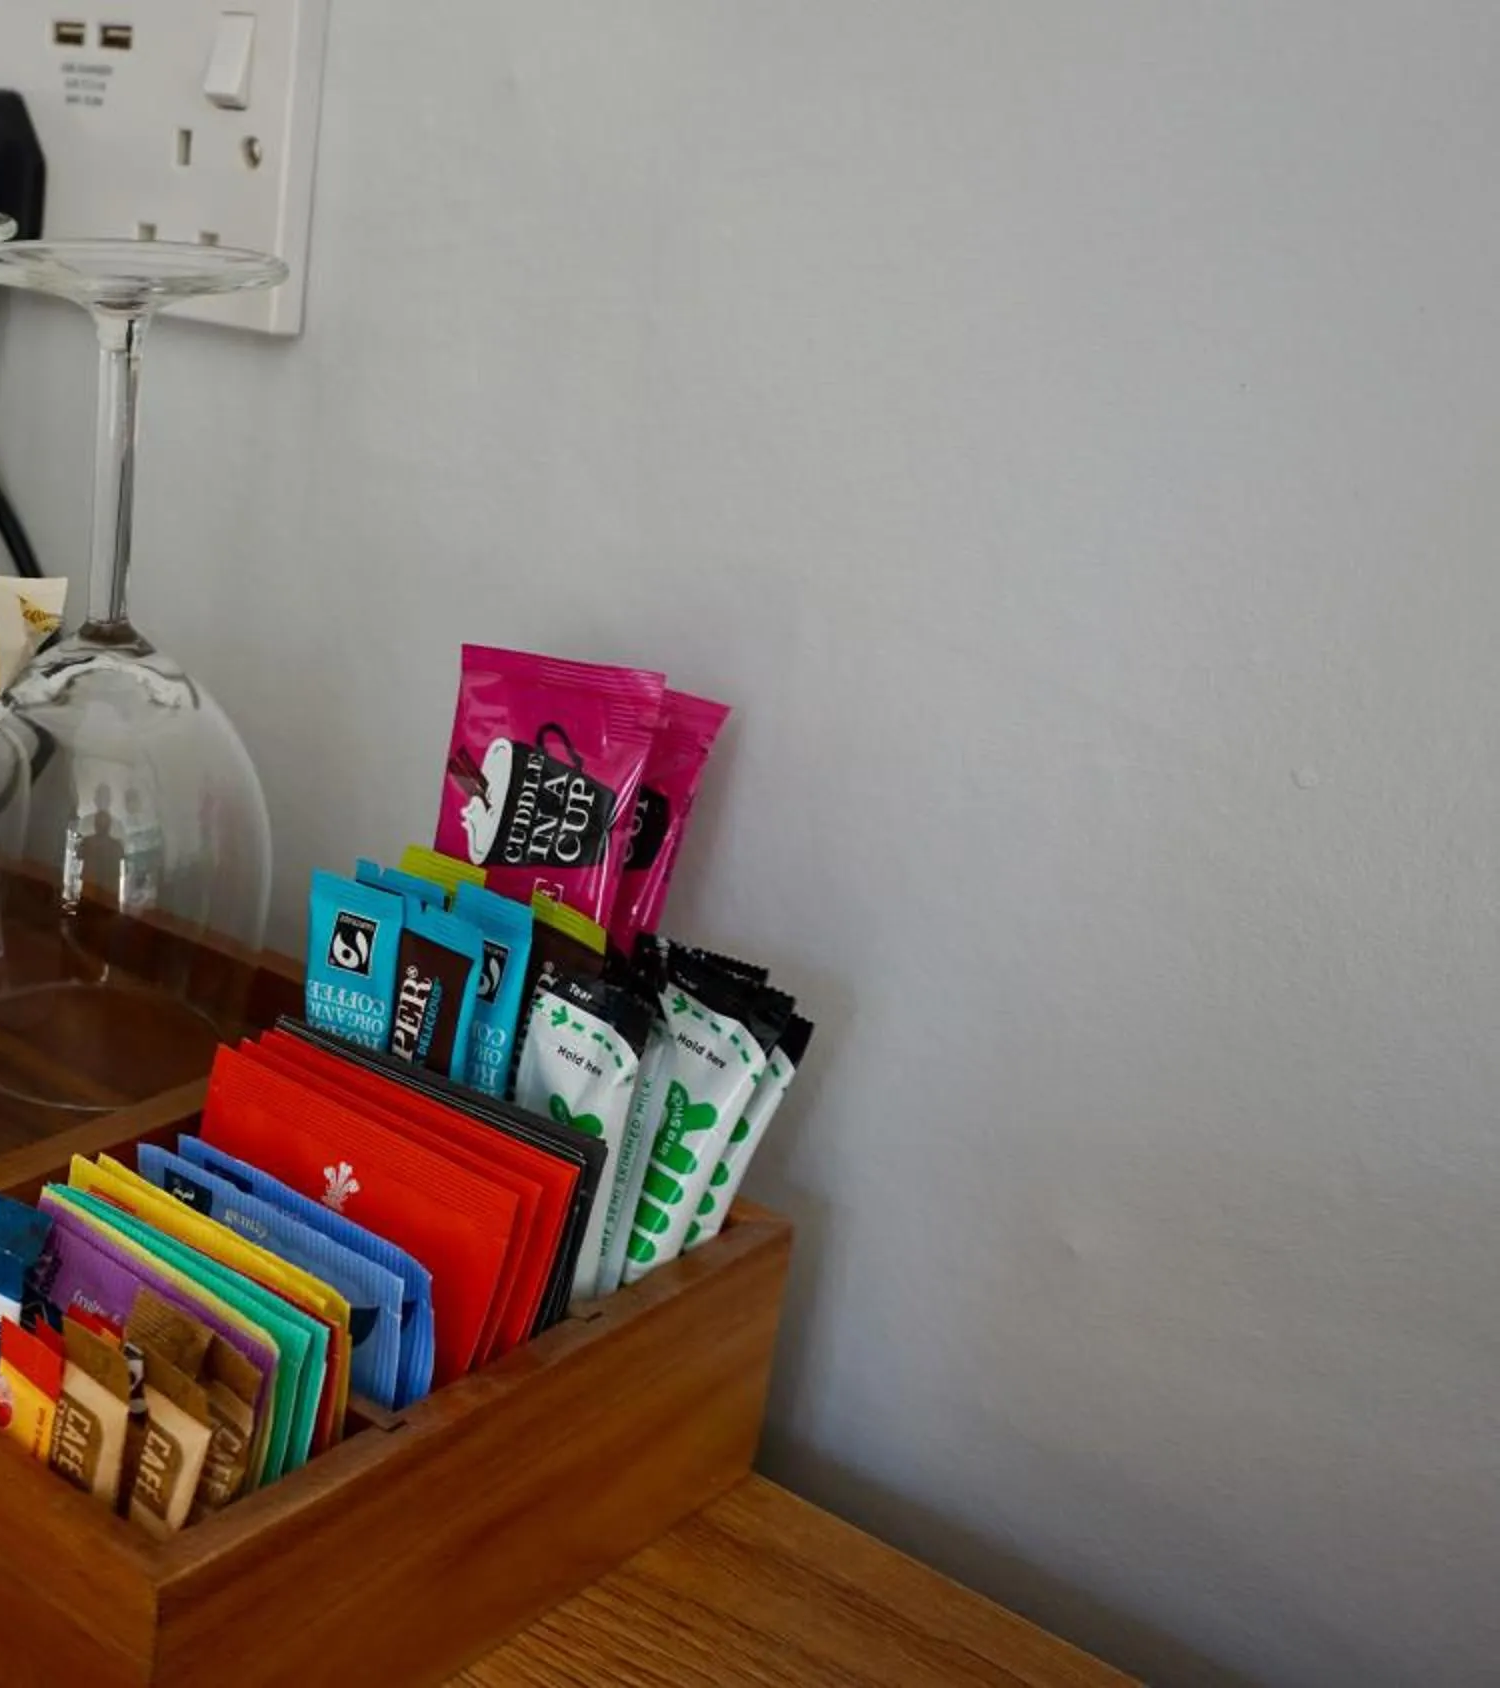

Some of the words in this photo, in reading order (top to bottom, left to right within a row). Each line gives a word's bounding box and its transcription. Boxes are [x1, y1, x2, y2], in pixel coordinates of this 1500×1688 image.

[503, 752, 546, 864] CUDDLE
[528, 811, 558, 862] IN
[544, 771, 570, 800] A
[554, 776, 597, 863] CUP
[557, 1045, 584, 1066] Hold
[677, 1032, 706, 1056] Hold
